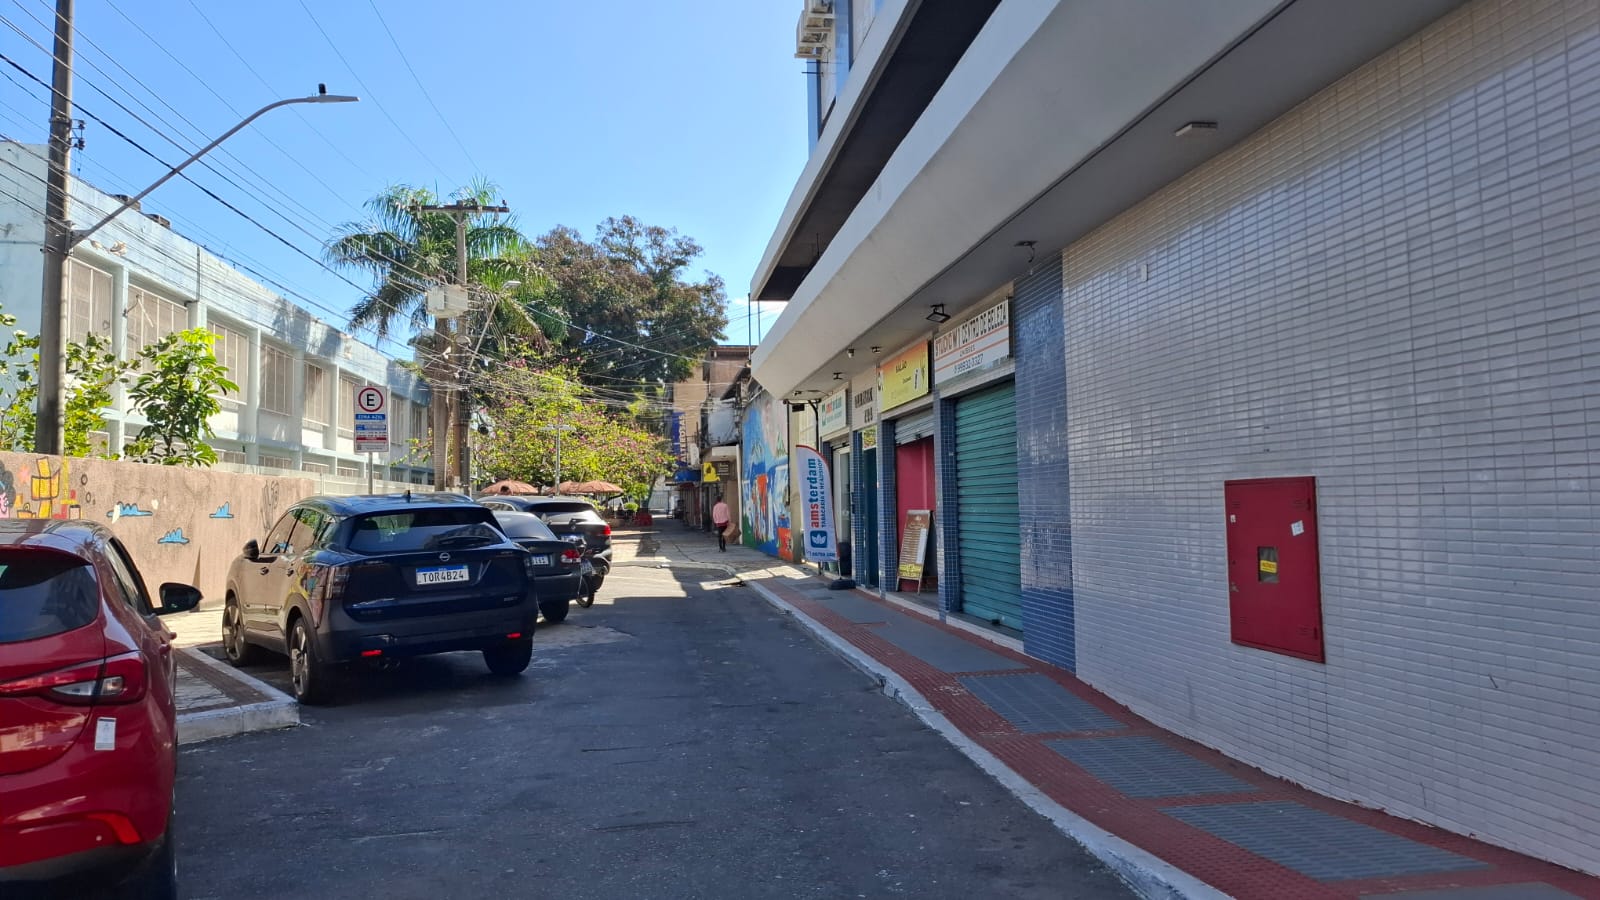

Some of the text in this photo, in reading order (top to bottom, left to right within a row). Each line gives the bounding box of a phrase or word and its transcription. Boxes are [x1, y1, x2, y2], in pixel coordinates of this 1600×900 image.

[935, 330, 953, 357] STUDIO
[962, 317, 979, 344] CENTRO
[980, 312, 987, 336] DE
[988, 302, 1006, 331] BELEZA
[366, 393, 375, 407] E
[806, 458, 820, 528] amsterdam
[422, 570, 464, 582] TOR4B24
